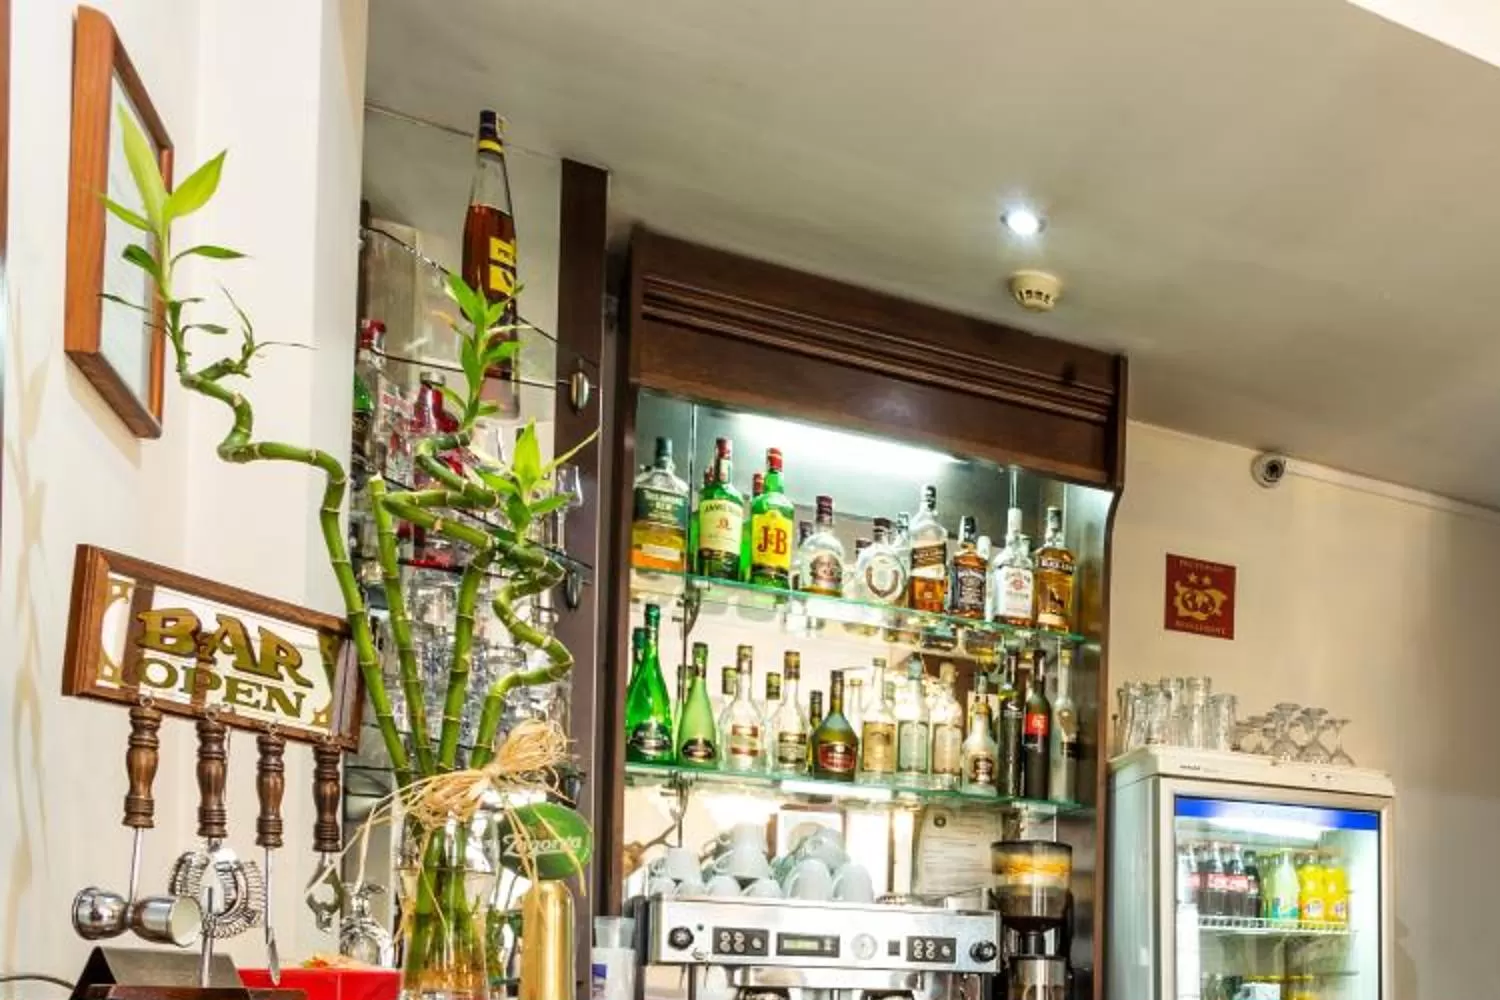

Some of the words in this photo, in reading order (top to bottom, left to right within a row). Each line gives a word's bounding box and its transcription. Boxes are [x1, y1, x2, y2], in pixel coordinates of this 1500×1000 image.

[136, 607, 314, 689] BAR
[138, 657, 307, 719] OPEN
[502, 833, 582, 857] Zgora
